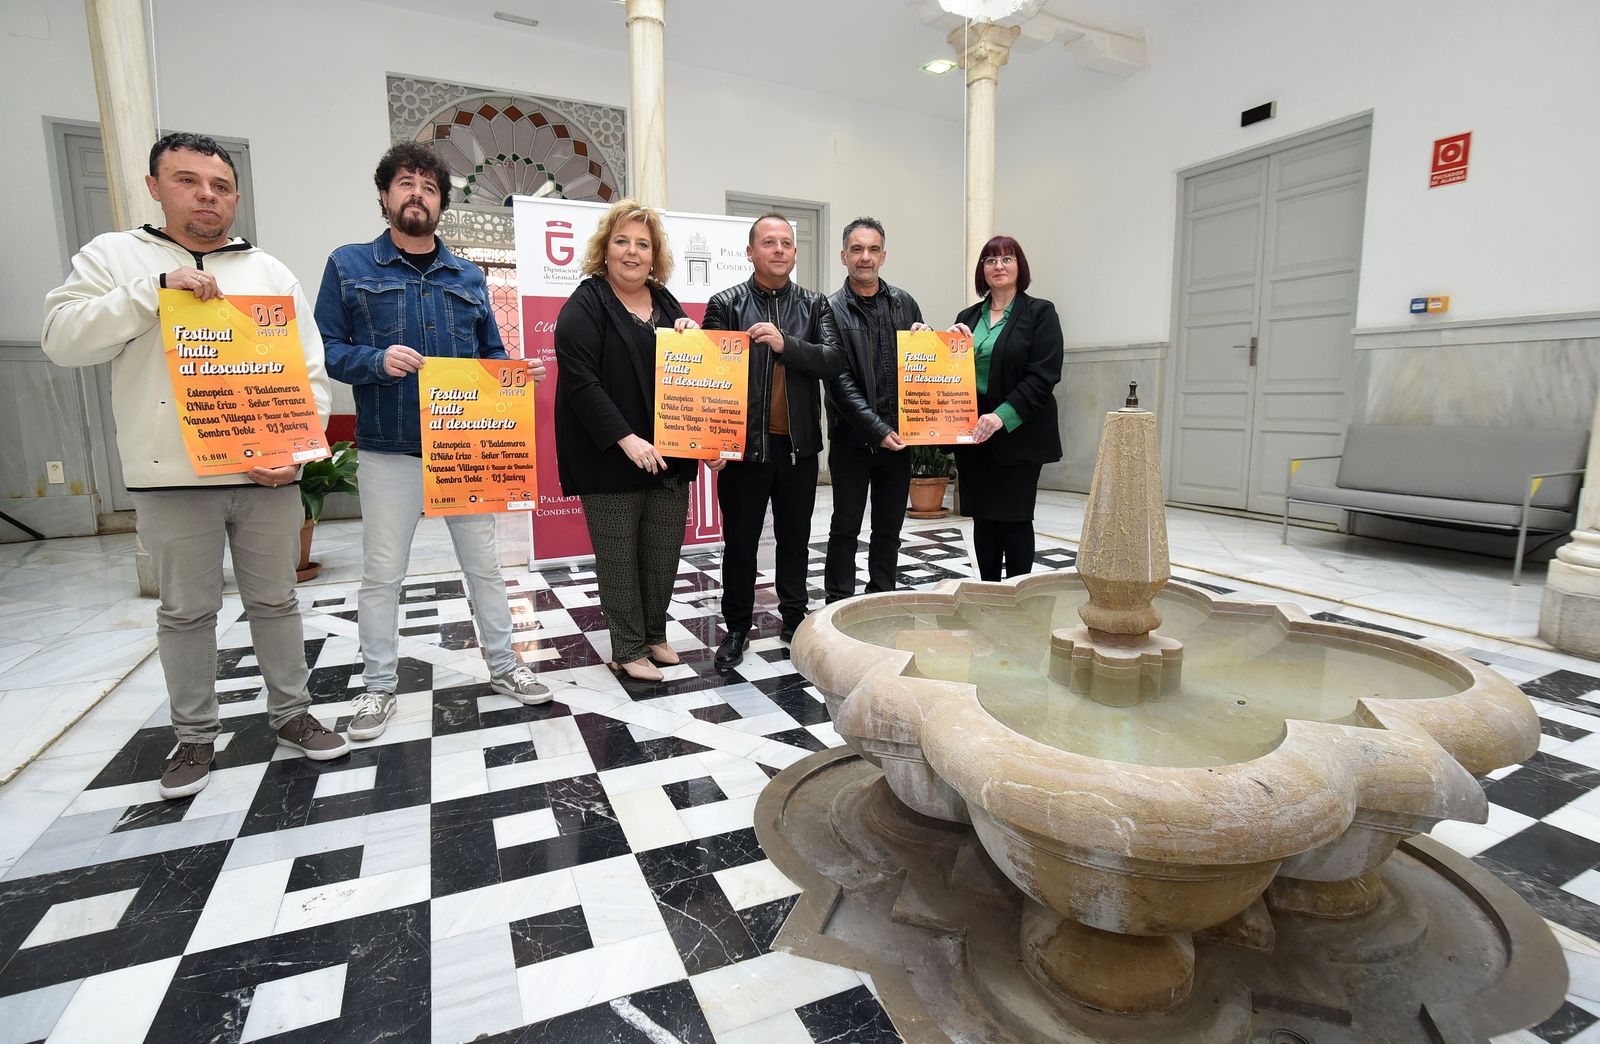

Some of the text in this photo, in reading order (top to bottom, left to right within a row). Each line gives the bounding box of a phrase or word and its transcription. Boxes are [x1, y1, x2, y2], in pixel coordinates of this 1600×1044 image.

[251, 303, 288, 326] 06
[172, 325, 232, 342] Festival
[176, 343, 218, 358] Indie
[664, 350, 703, 363] Festival
[179, 361, 284, 376] al descubierto
[664, 364, 690, 374] Indie
[498, 368, 526, 387] 06
[662, 376, 732, 390] al descubierto
[187, 388, 234, 399] Estenopeica
[429, 388, 478, 400] Festival
[217, 400, 236, 410] Erizo
[248, 398, 270, 408] Señor
[272, 398, 306, 406] Torrance
[429, 403, 464, 416] Indie
[183, 416, 220, 426] Vanessa
[221, 414, 256, 424] Villegas
[429, 418, 517, 430] al descubierto
[198, 422, 308, 438] Sombra Doble DJ Javirey
[432, 441, 470, 450] Estenopeica
[455, 452, 472, 460] Erizo
[481, 452, 500, 460] Señor
[426, 465, 456, 473] Vanessa
[457, 464, 485, 473] Villegas
[436, 476, 462, 484] Sombra
[492, 474, 502, 483] DJ
[502, 474, 526, 483] Javirey
[536, 508, 570, 516] CONDES
